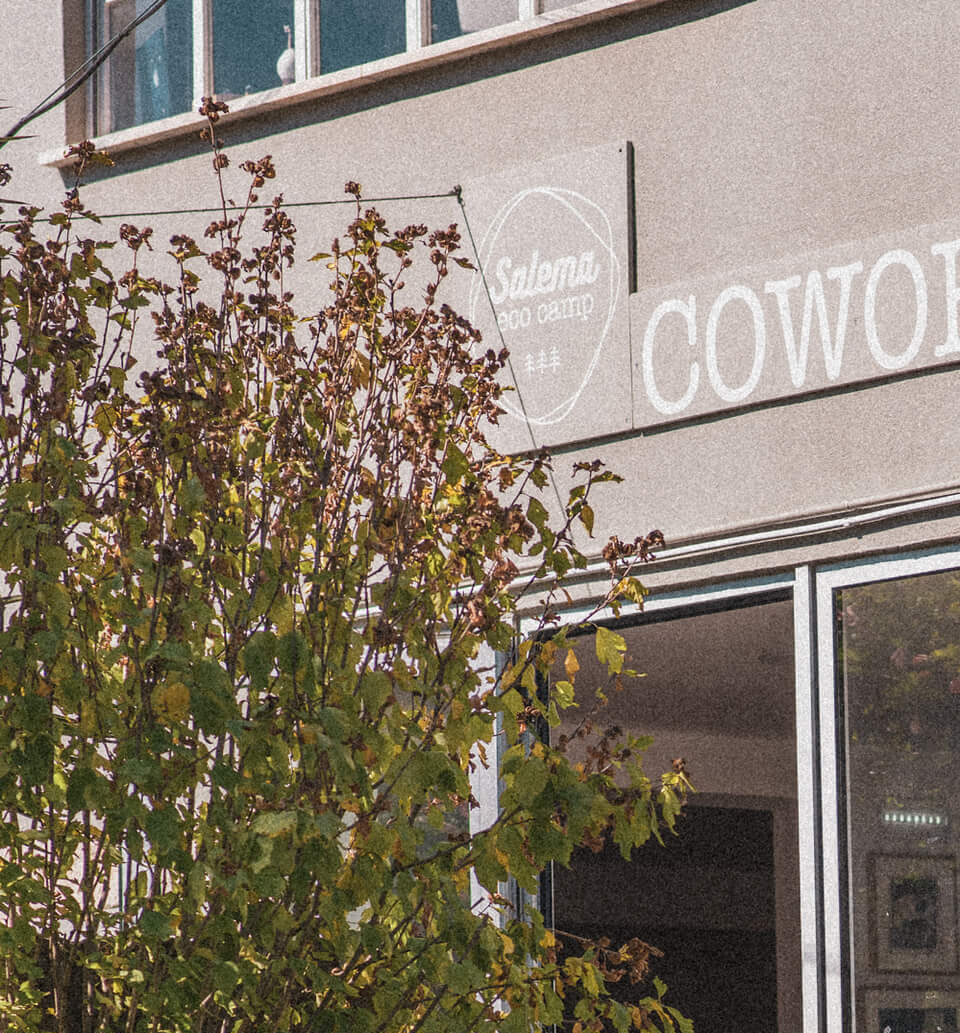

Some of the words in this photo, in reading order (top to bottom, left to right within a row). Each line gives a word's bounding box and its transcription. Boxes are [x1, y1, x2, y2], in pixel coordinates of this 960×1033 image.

[489, 249, 600, 304] Salema
[498, 307, 531, 332] eco
[537, 293, 594, 324] camp
